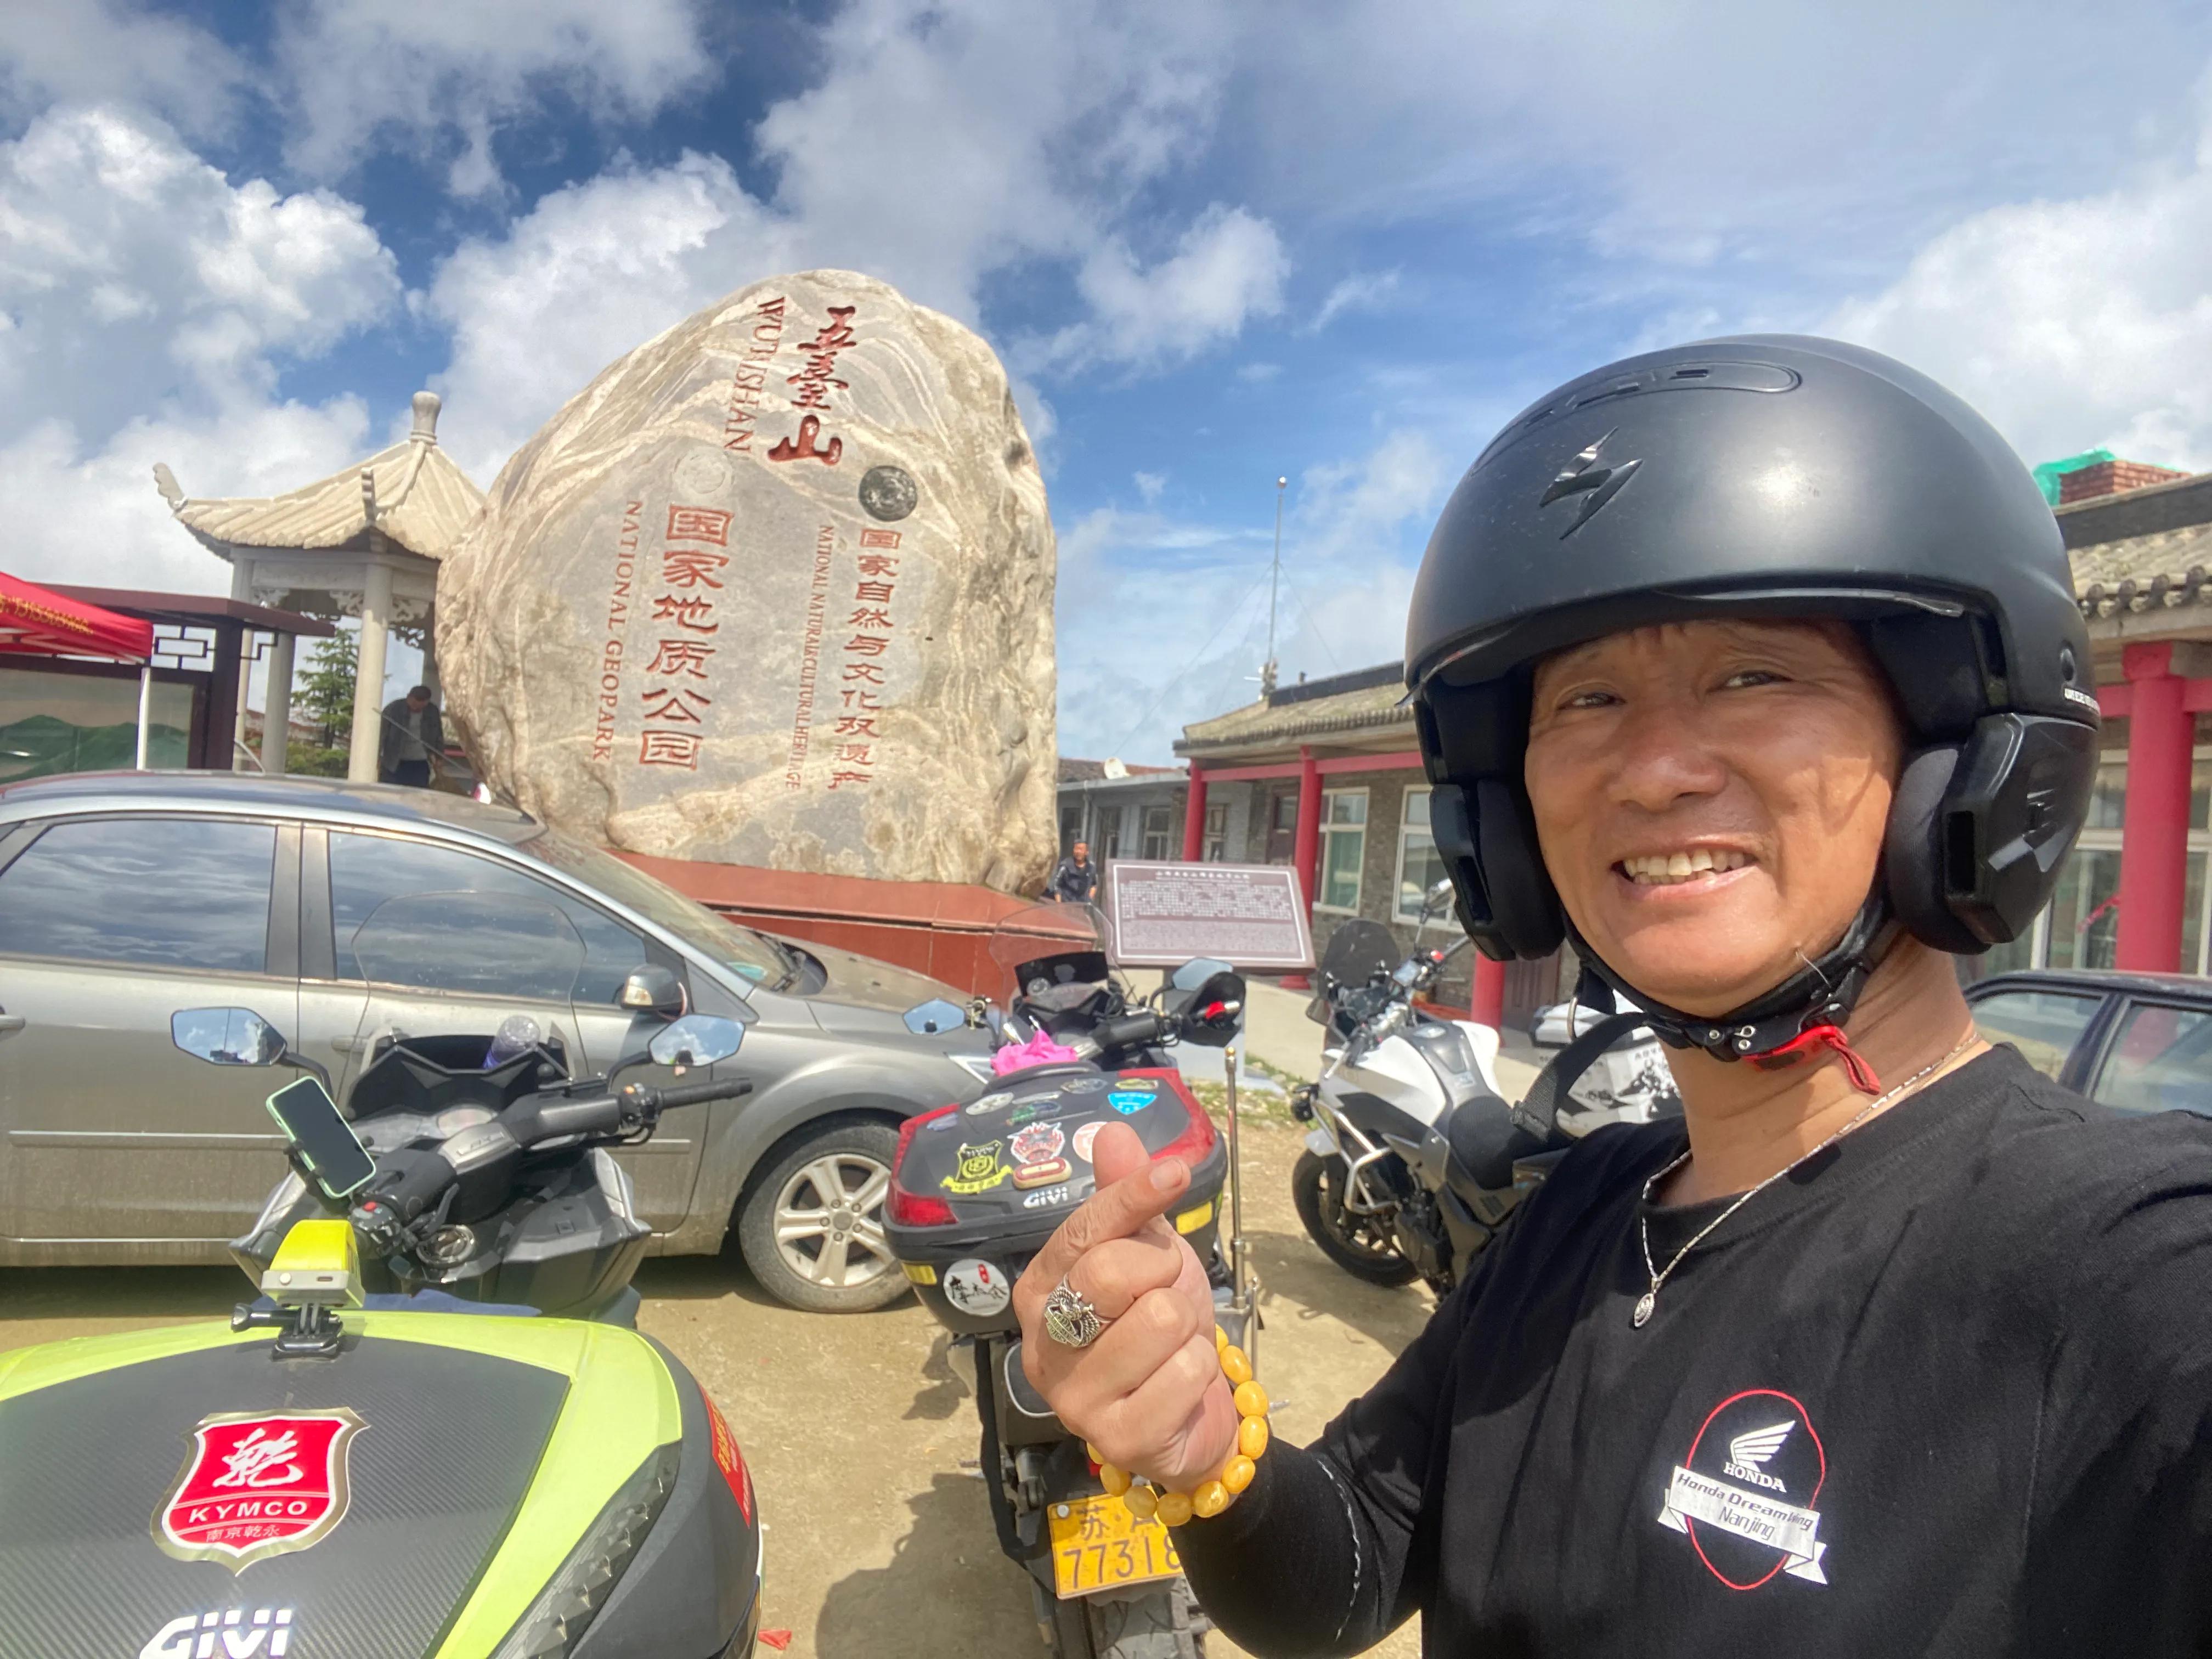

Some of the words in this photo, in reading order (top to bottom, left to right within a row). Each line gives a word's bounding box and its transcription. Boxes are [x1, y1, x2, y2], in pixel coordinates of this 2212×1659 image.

[607, 500, 643, 630] NATIONAL
[812, 524, 834, 589] NATIONAL
[639, 504, 735, 770] 国家地质公园
[828, 528, 902, 790] 国家自然与文化双遗产
[593, 640, 624, 761] GEOPARK
[1676, 1473, 1725, 1499] Honda
[1723, 1462, 1787, 1493] HONDA
[189, 1500, 308, 1523] KYMCO
[1718, 1506, 1775, 1541] Nanjing
[1062, 1535, 1181, 1589] 77318
